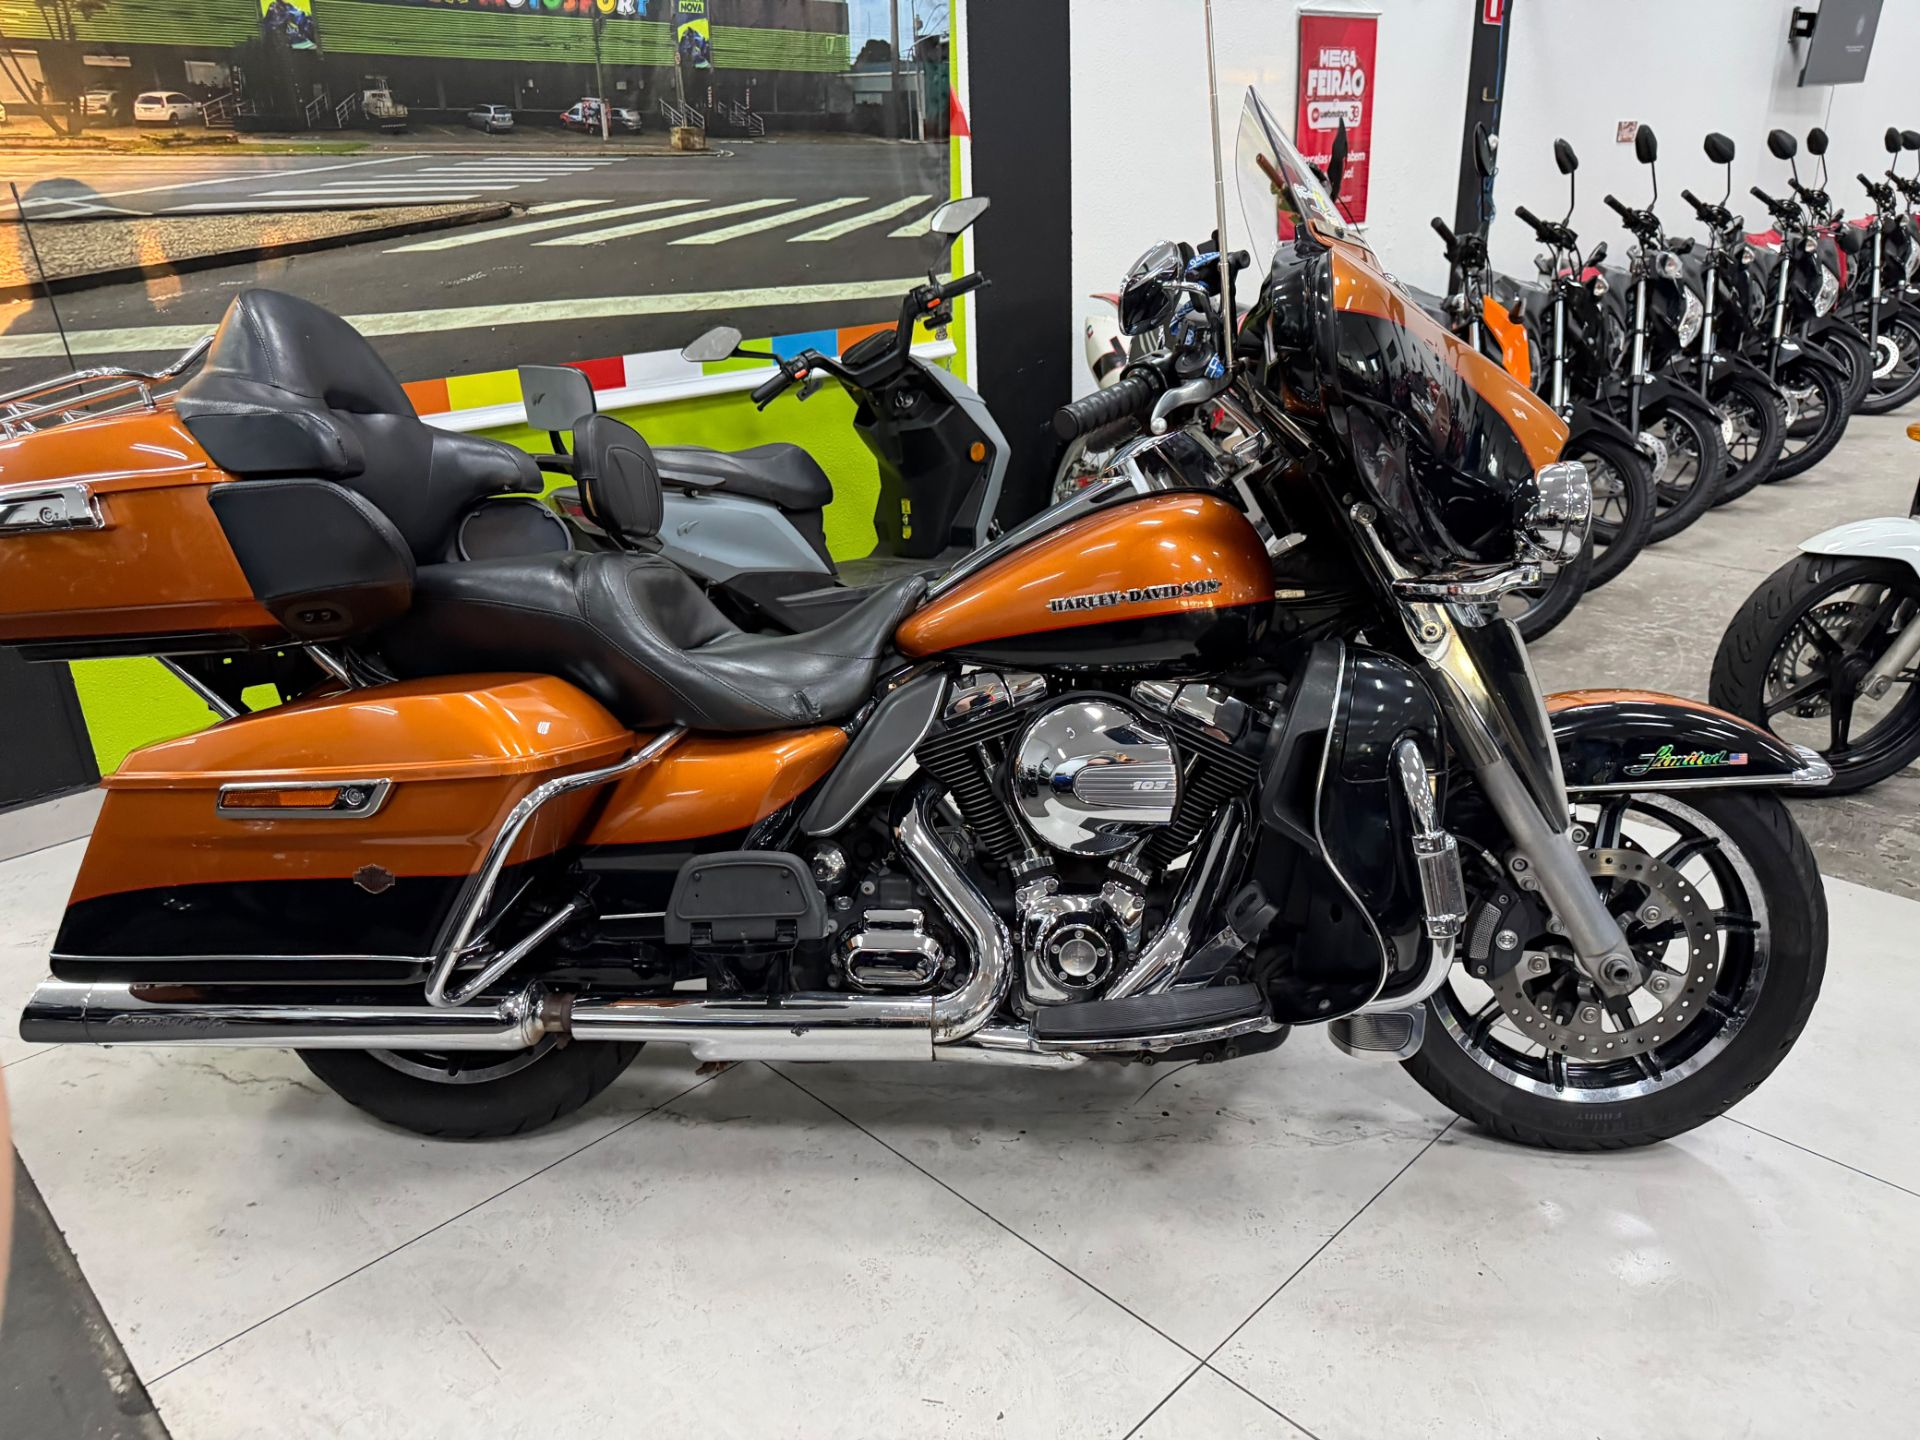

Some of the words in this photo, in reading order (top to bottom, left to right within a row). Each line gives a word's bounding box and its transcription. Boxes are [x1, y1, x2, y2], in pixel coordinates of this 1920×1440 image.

[680, 2, 703, 12] NOVA
[1319, 49, 1357, 68] MEGA
[1307, 66, 1365, 96] FEIRÃO
[1623, 744, 1730, 776] Limited
[1132, 780, 1168, 791] 103
